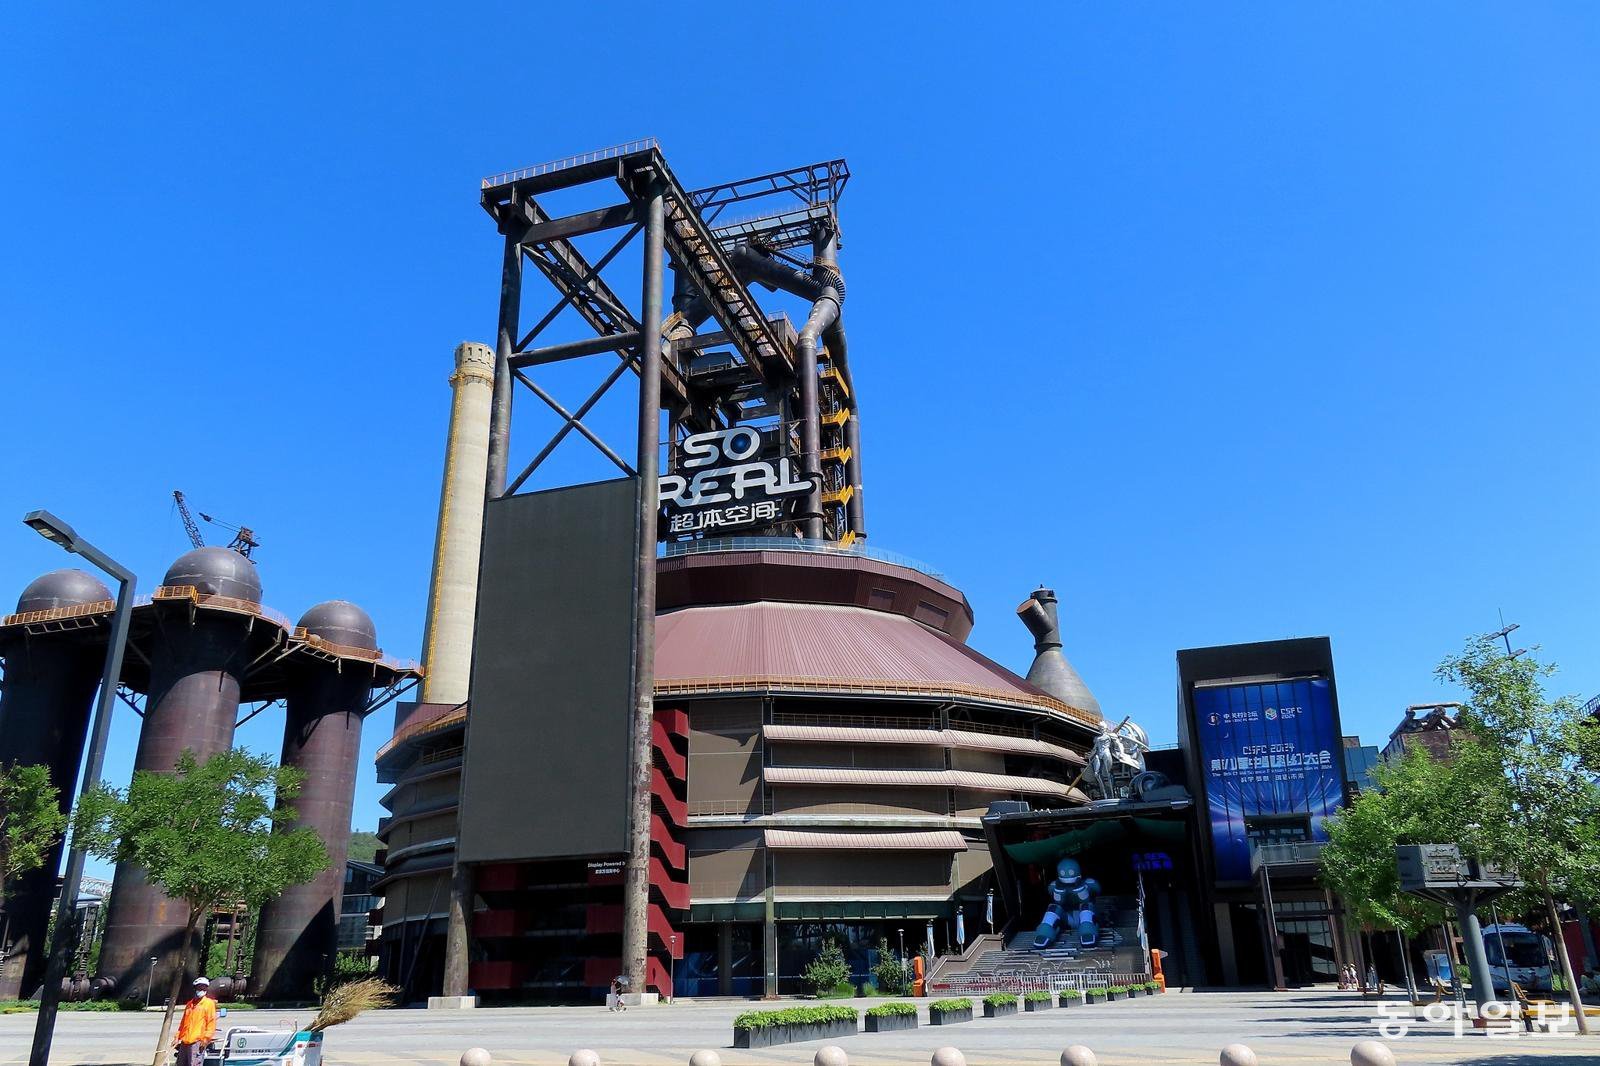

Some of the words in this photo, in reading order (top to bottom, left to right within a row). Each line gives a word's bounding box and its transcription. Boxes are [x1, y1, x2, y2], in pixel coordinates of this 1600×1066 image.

[683, 427, 760, 468] SO
[657, 458, 813, 508] REAL
[669, 501, 779, 532] 超体空间
